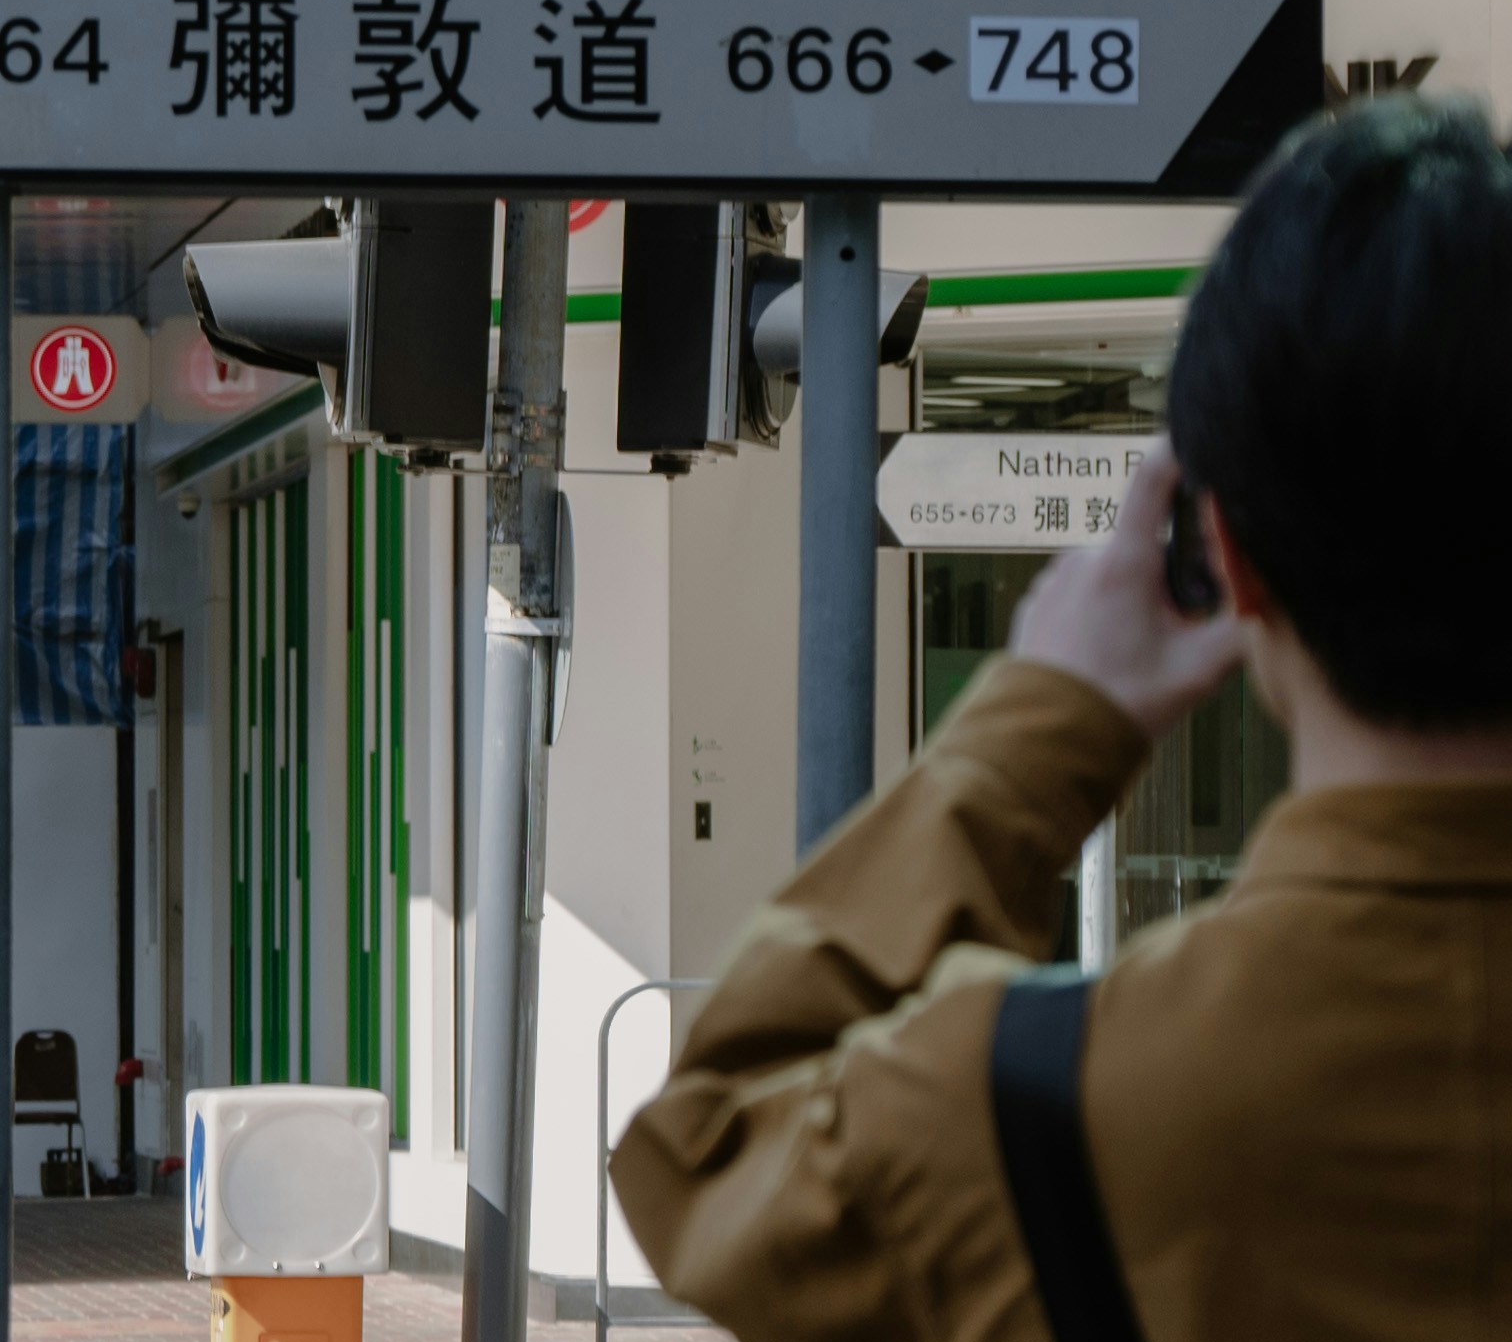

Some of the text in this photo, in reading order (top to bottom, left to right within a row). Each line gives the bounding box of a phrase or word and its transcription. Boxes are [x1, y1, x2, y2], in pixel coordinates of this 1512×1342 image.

[727, 26, 1135, 95] 666 748
[998, 449, 1112, 478] Nathan
[910, 504, 1017, 525] 655 673
[1034, 496, 1119, 533] 彌敦
